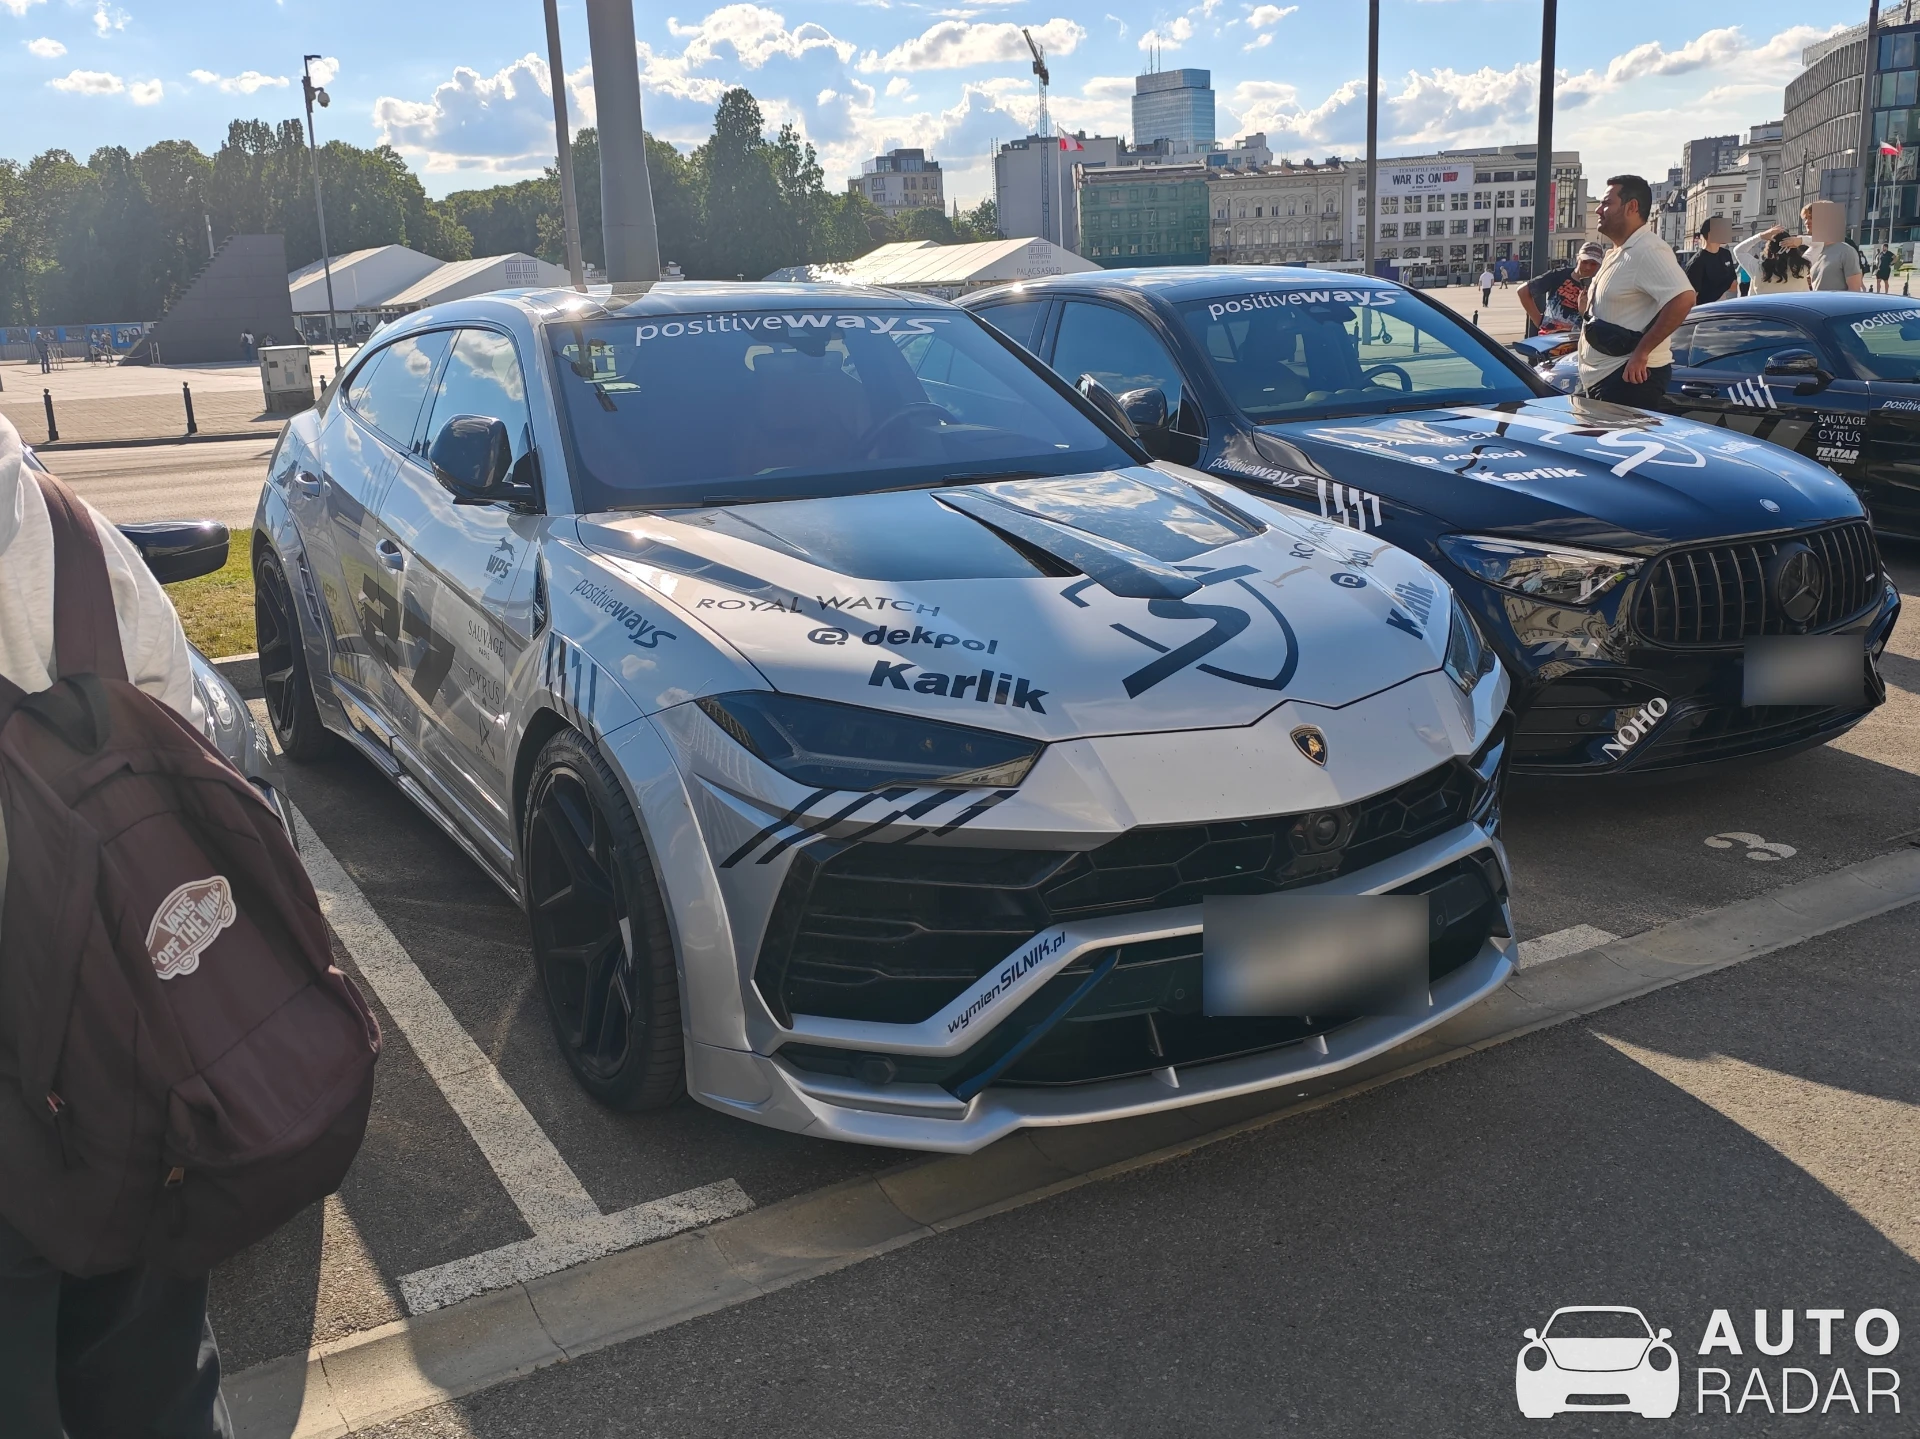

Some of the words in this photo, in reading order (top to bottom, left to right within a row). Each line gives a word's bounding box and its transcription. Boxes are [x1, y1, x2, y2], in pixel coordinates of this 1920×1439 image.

[1392, 174, 1411, 185] WAR
[1415, 173, 1424, 184] IS
[1428, 172, 1441, 184] ON
[1208, 290, 1400, 321] positiveways
[636, 312, 951, 346] positiveways
[1818, 414, 1866, 426] SAUVAGE
[1818, 429, 1861, 443] CYRUS
[1443, 450, 1527, 461] dekpol
[1816, 446, 1859, 460] TEXTAR
[1207, 456, 1316, 488] positiveways
[1471, 467, 1587, 482] Karlik
[485, 554, 513, 579] WPS
[570, 578, 677, 649] positiveways
[695, 596, 803, 613] ROYAL
[815, 595, 941, 617] WATCH
[468, 619, 504, 658] SAUVAGE
[861, 625, 998, 654] dekpol
[468, 667, 500, 705] CYRUS
[868, 660, 1049, 715] Karlik
[1601, 697, 1668, 760] NOHO
[157, 892, 196, 936] VANS
[175, 911, 209, 946] THE
